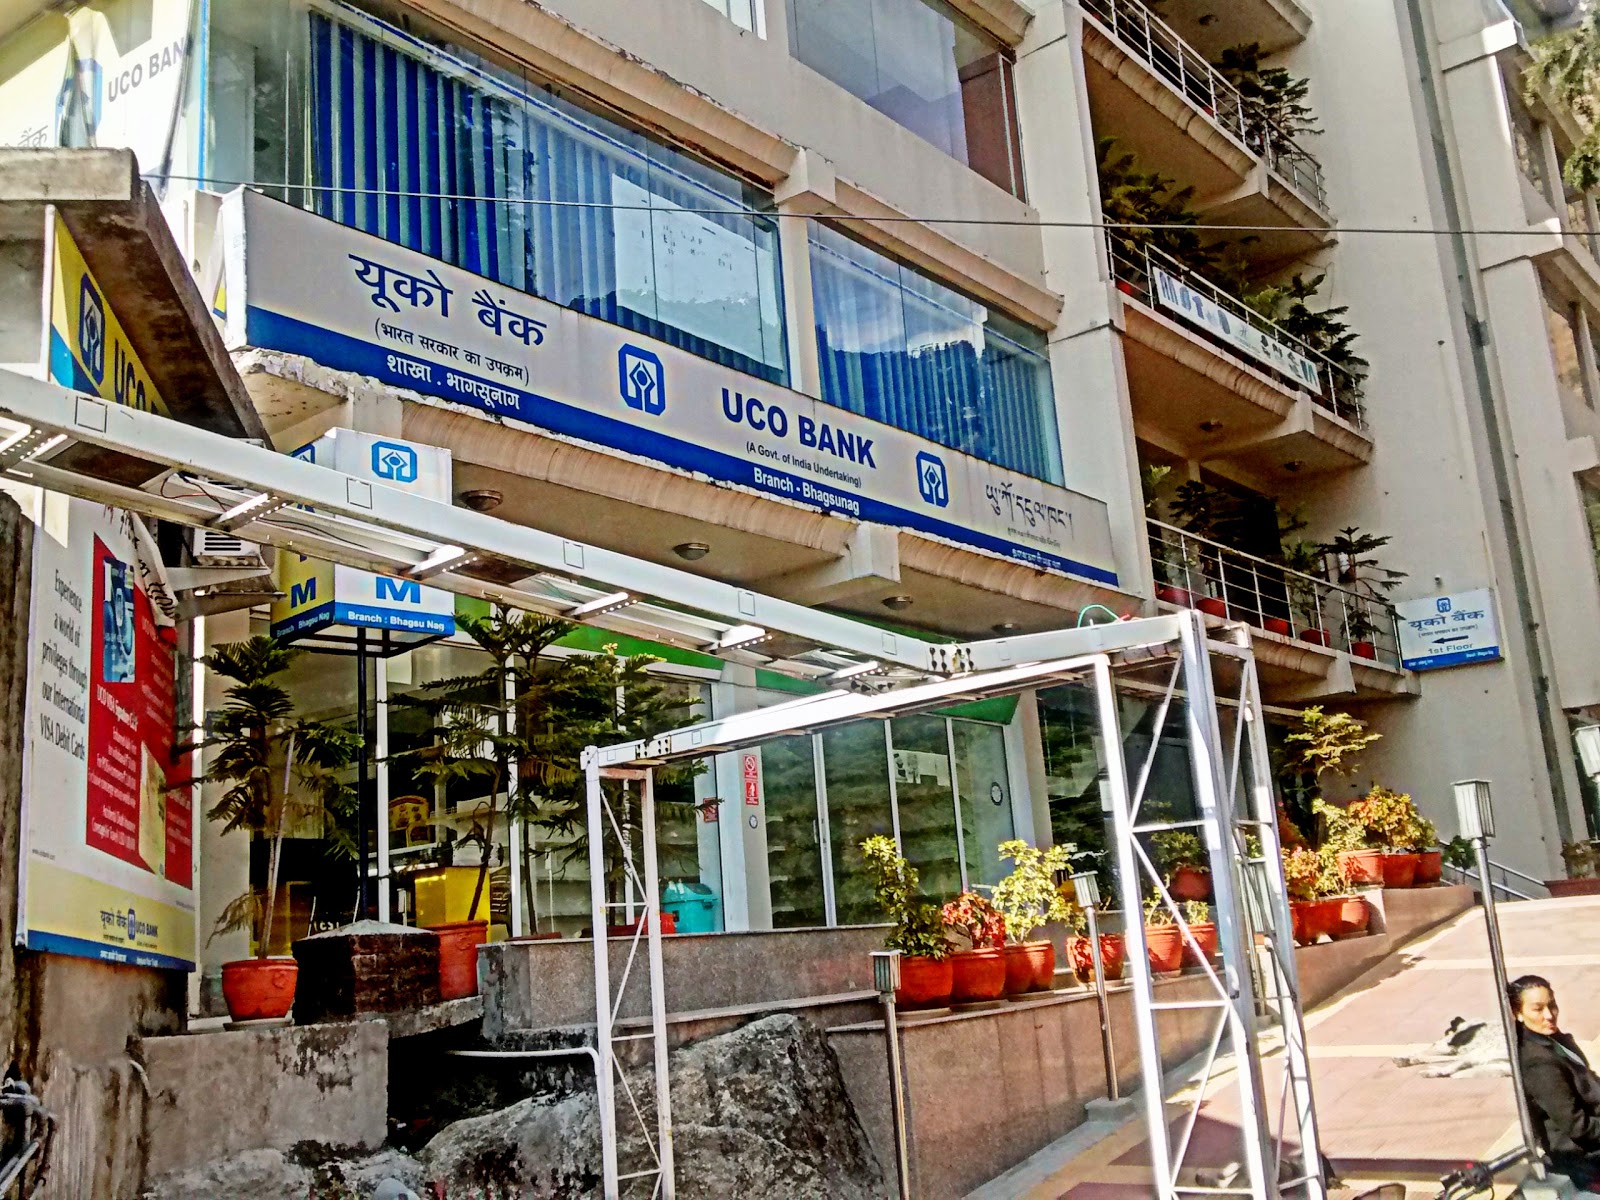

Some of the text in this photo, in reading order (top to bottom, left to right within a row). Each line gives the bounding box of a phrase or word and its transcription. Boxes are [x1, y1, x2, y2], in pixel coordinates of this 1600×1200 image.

[108, 34, 194, 102] UCO BAN
[349, 253, 547, 347] यूको बैंक
[419, 334, 459, 360] सरकार
[465, 349, 482, 367] का
[386, 354, 432, 384] शाखा
[721, 387, 877, 469] UCO BANK
[758, 444, 781, 461] Govt.
[781, 454, 791, 465] of
[792, 457, 812, 471] India
[813, 463, 862, 489] Undertaking)
[754, 467, 793, 494] Branch
[802, 482, 860, 516] Bhagsunag
[55, 569, 82, 613] Experience
[59, 615, 74, 643] world
[75, 626, 81, 648] of
[319, 611, 330, 622] Nag
[348, 611, 382, 624] Branch
[390, 613, 425, 629] Bhagsu
[427, 619, 445, 632] Nag
[1408, 613, 1446, 631] यूको
[1451, 610, 1484, 621] बैंक
[1446, 643, 1473, 652] Floor
[40, 713, 54, 744] VISA
[56, 722, 70, 753] Debit
